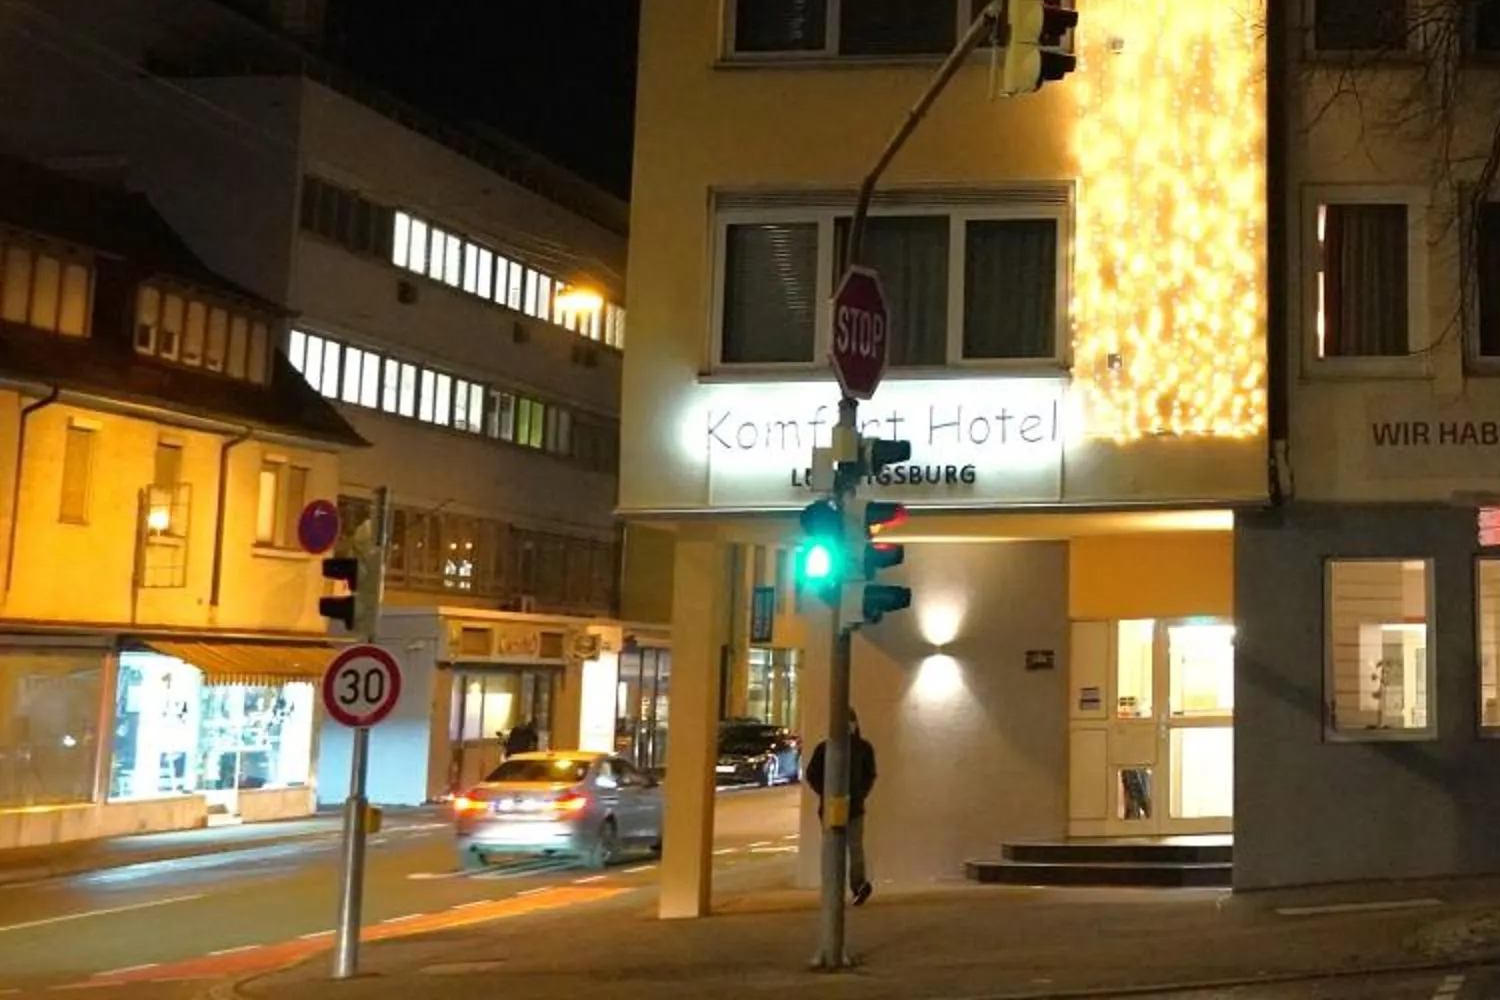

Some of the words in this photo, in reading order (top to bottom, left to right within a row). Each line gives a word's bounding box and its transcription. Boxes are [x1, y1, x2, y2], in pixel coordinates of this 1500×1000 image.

[837, 304, 884, 359] STOP
[706, 404, 905, 450] Komfrt
[929, 400, 1057, 445] Hotel
[1372, 421, 1430, 446] WIR
[340, 668, 384, 704] 30
